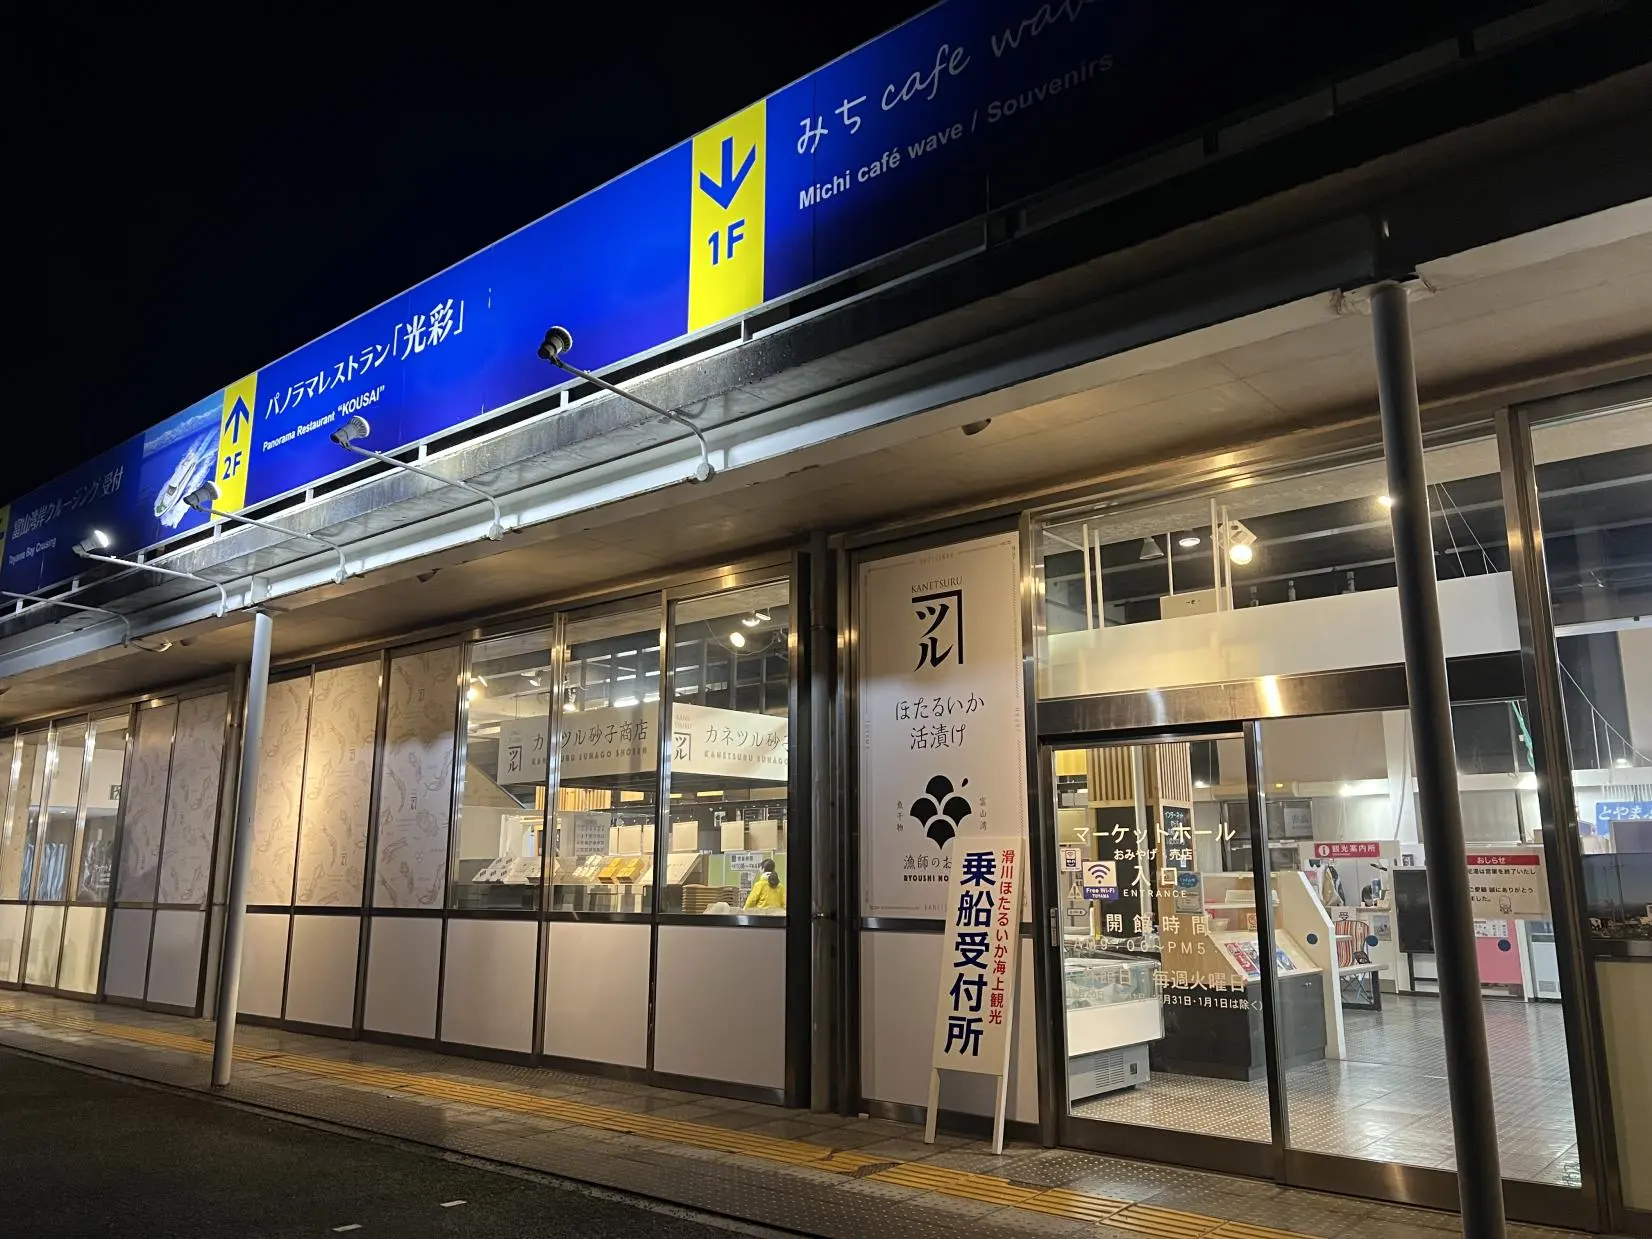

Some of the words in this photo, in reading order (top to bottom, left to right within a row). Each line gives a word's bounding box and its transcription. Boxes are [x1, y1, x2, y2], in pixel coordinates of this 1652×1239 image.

[797, 95, 867, 154] みち
[881, 44, 971, 111] cafe
[990, 0, 1100, 58] wav
[799, 171, 850, 210] Michi
[857, 147, 901, 183] café
[907, 123, 964, 160] wave
[987, 53, 1115, 123] Souvenirs
[708, 218, 746, 266] 1F
[264, 298, 465, 421] パノラマレストラン「光彩」
[262, 428, 297, 453] Panorama
[296, 410, 336, 437] Restaurant
[223, 451, 243, 481] 2F
[911, 575, 964, 594] KANETSURU
[914, 603, 954, 673] ツル
[895, 692, 985, 721] ほたるいか
[532, 718, 649, 752] カツル砂子商店
[910, 723, 967, 751] 活漬け
[1073, 822, 1237, 845] マーケットホール
[1476, 857, 1506, 865] おしらせ
[903, 874, 936, 883] RYOUSHI
[1131, 865, 1179, 888] 入口
[1123, 888, 1189, 899] ENTRANCE
[988, 850, 1015, 1025] 滑川ほたるいか海上観光
[1106, 913, 1213, 936] 開館時間
[944, 851, 997, 1057] 乗船受付所
[1152, 969, 1246, 993] 毎週火曜日
